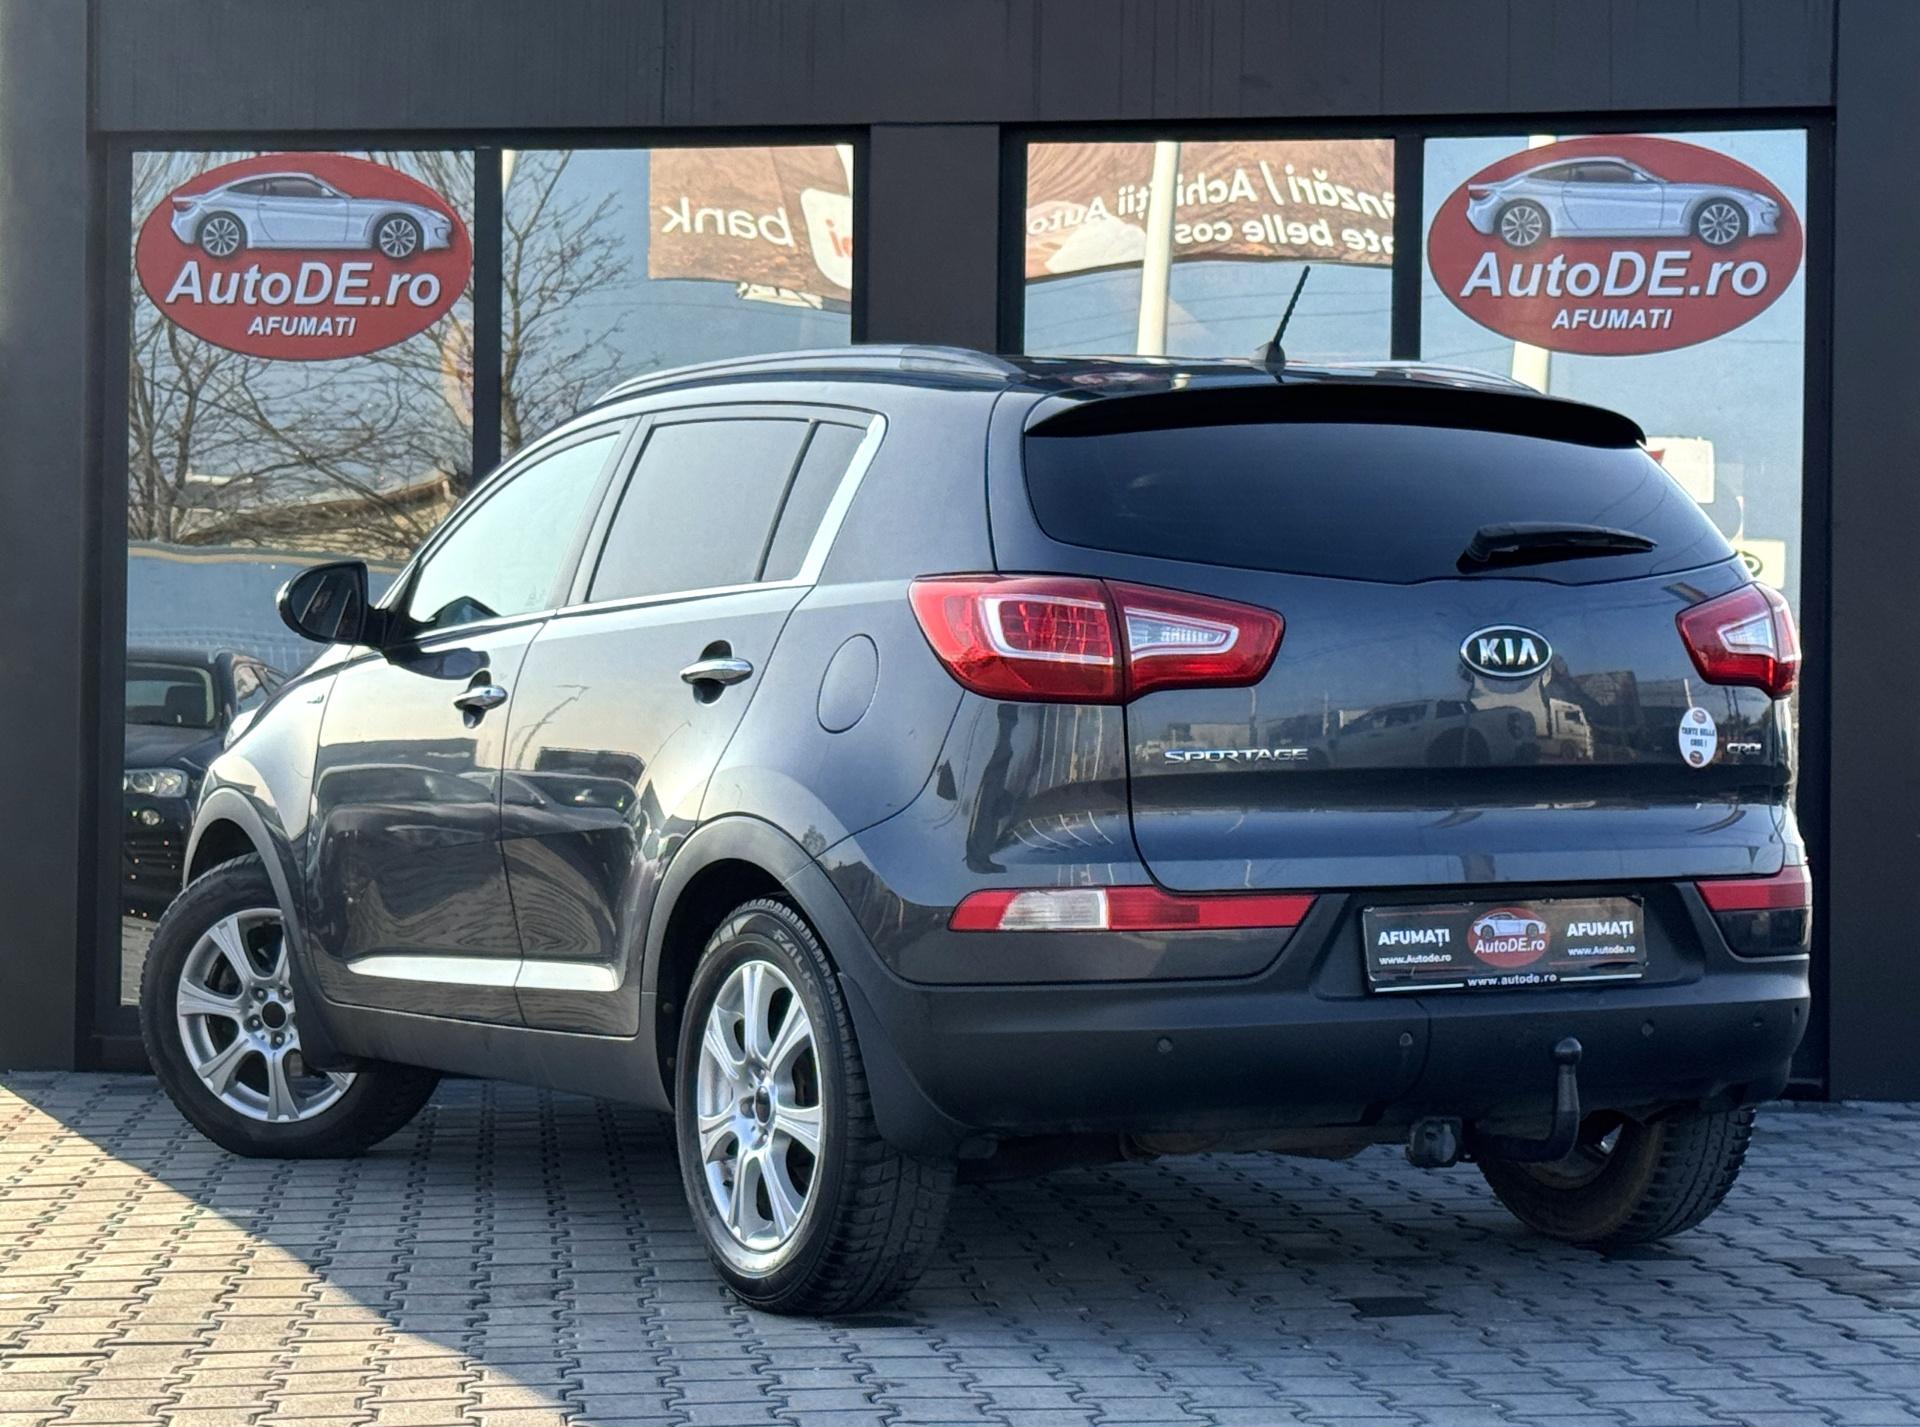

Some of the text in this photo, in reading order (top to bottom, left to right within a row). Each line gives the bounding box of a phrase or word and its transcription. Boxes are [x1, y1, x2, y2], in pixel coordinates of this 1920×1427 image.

[165, 260, 441, 307] AutoDE.ro
[1460, 250, 1768, 298] AutoDE.ro
[247, 316, 356, 337] AFUMATI
[1552, 308, 1672, 330] AFUMATI
[1478, 637, 1540, 667] KIA
[1164, 748, 1309, 765] SPORTAGE
[1473, 937, 1546, 955] AutoDE.ro
[1568, 945, 1636, 957] www.Autode.ro
[1379, 953, 1452, 966] www.Autode.ro
[1467, 973, 1558, 987] www.autode.ro
